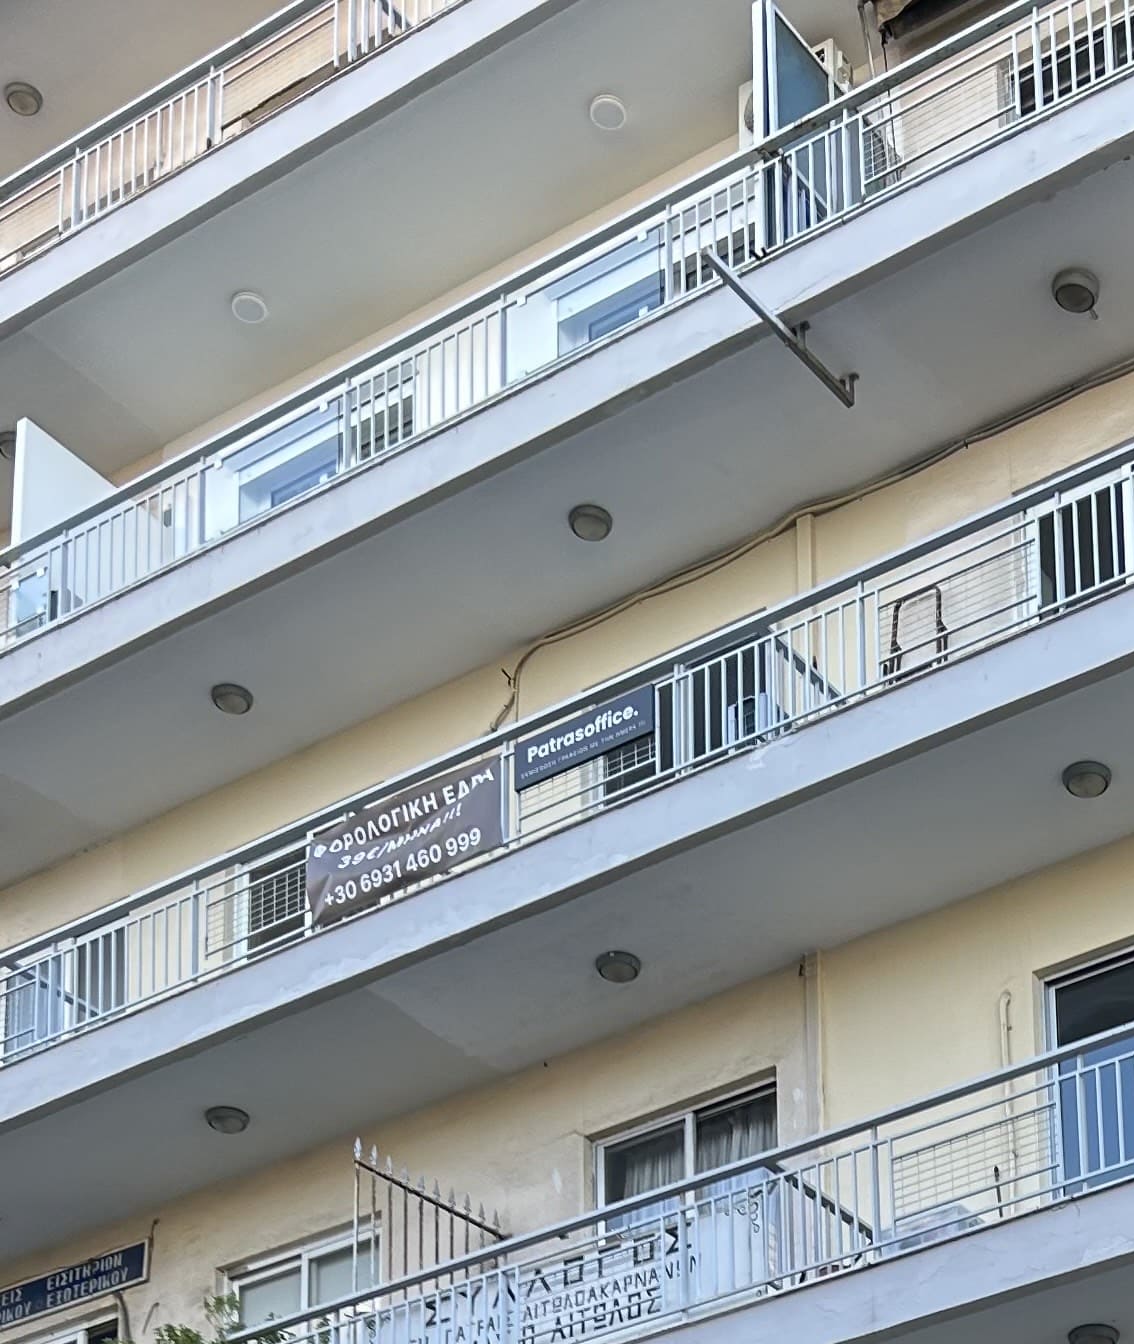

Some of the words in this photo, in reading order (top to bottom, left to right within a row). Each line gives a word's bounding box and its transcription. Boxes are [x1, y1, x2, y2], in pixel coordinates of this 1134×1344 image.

[324, 880, 358, 907] +30
[360, 860, 403, 896] 6931
[405, 843, 443, 874] 460
[446, 827, 482, 858] 999
